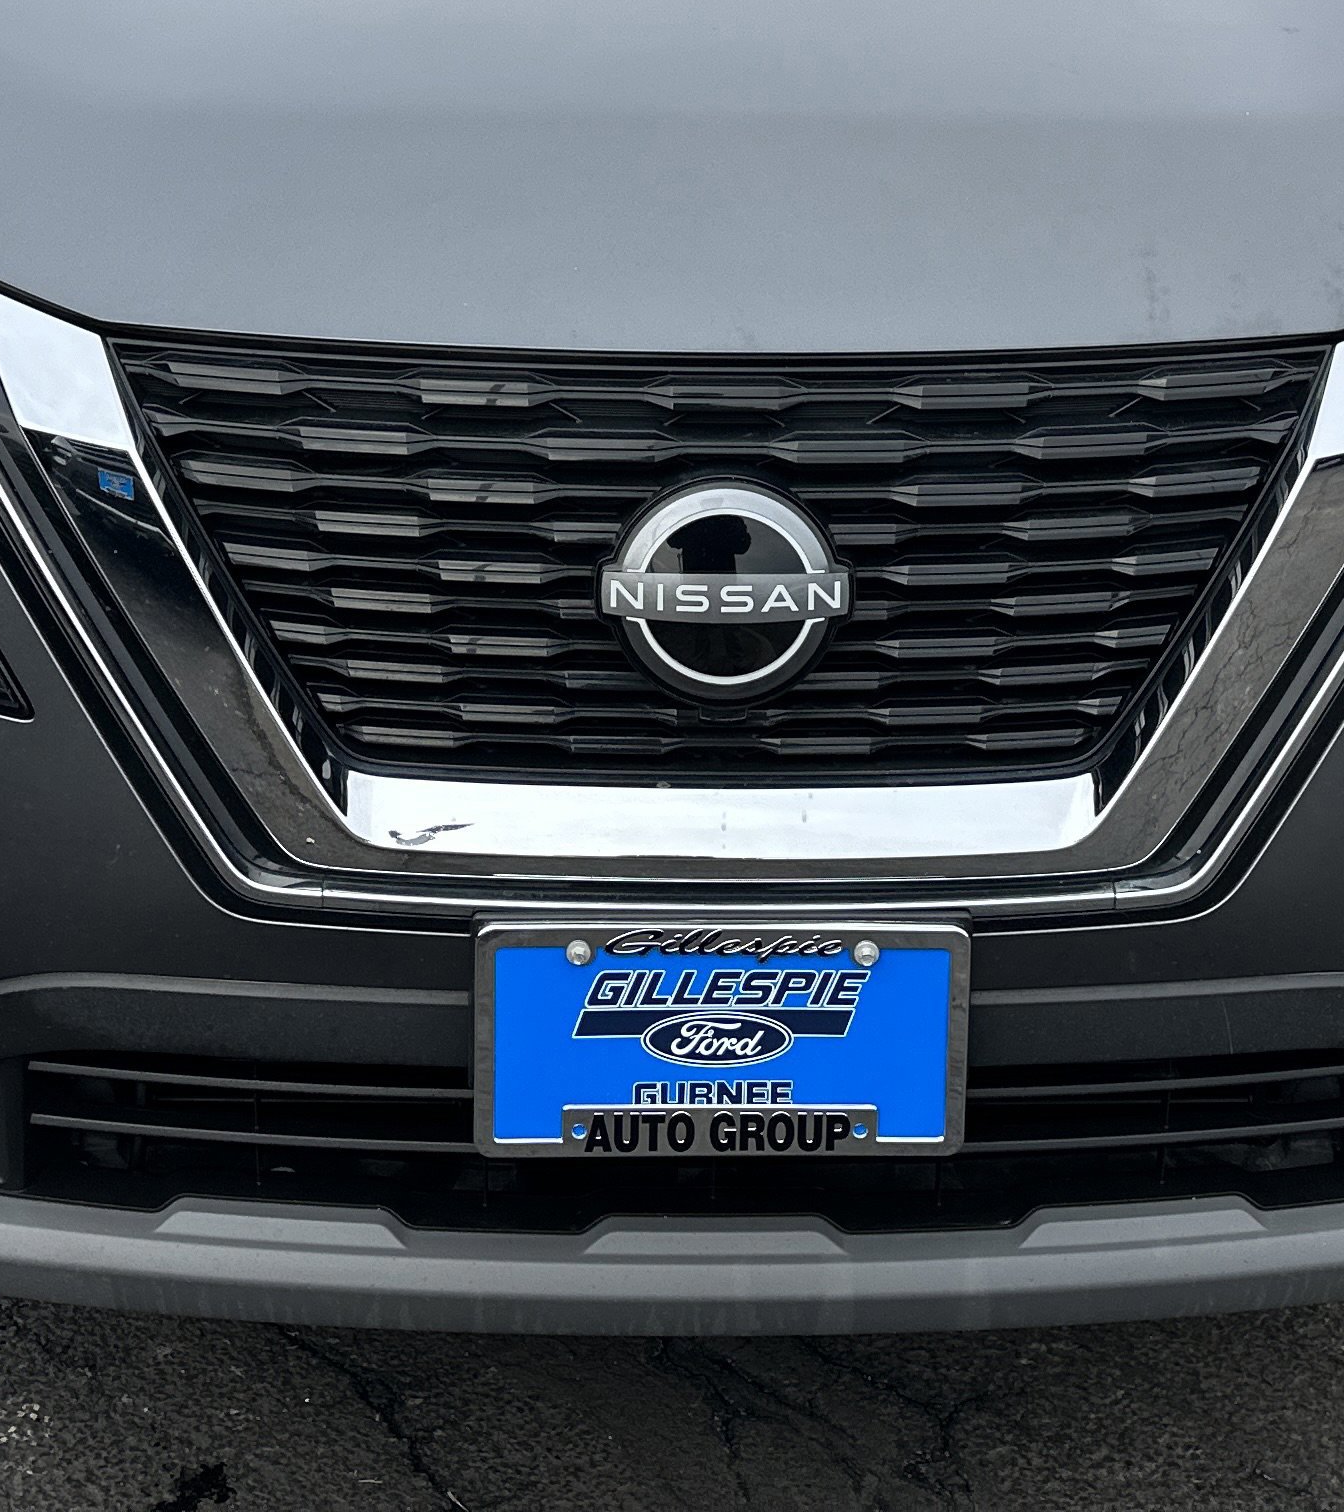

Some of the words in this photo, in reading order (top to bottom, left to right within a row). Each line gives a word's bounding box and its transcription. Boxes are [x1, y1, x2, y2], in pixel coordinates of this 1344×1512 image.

[610, 579, 842, 613] NISSAN
[605, 928, 844, 963] Gillespie
[584, 969, 871, 1008] GILLESPIE
[669, 1020, 763, 1057] Ford
[632, 1080, 794, 1105] GURNEE
[584, 1111, 696, 1152] AUTO
[708, 1111, 852, 1152] GROUP
